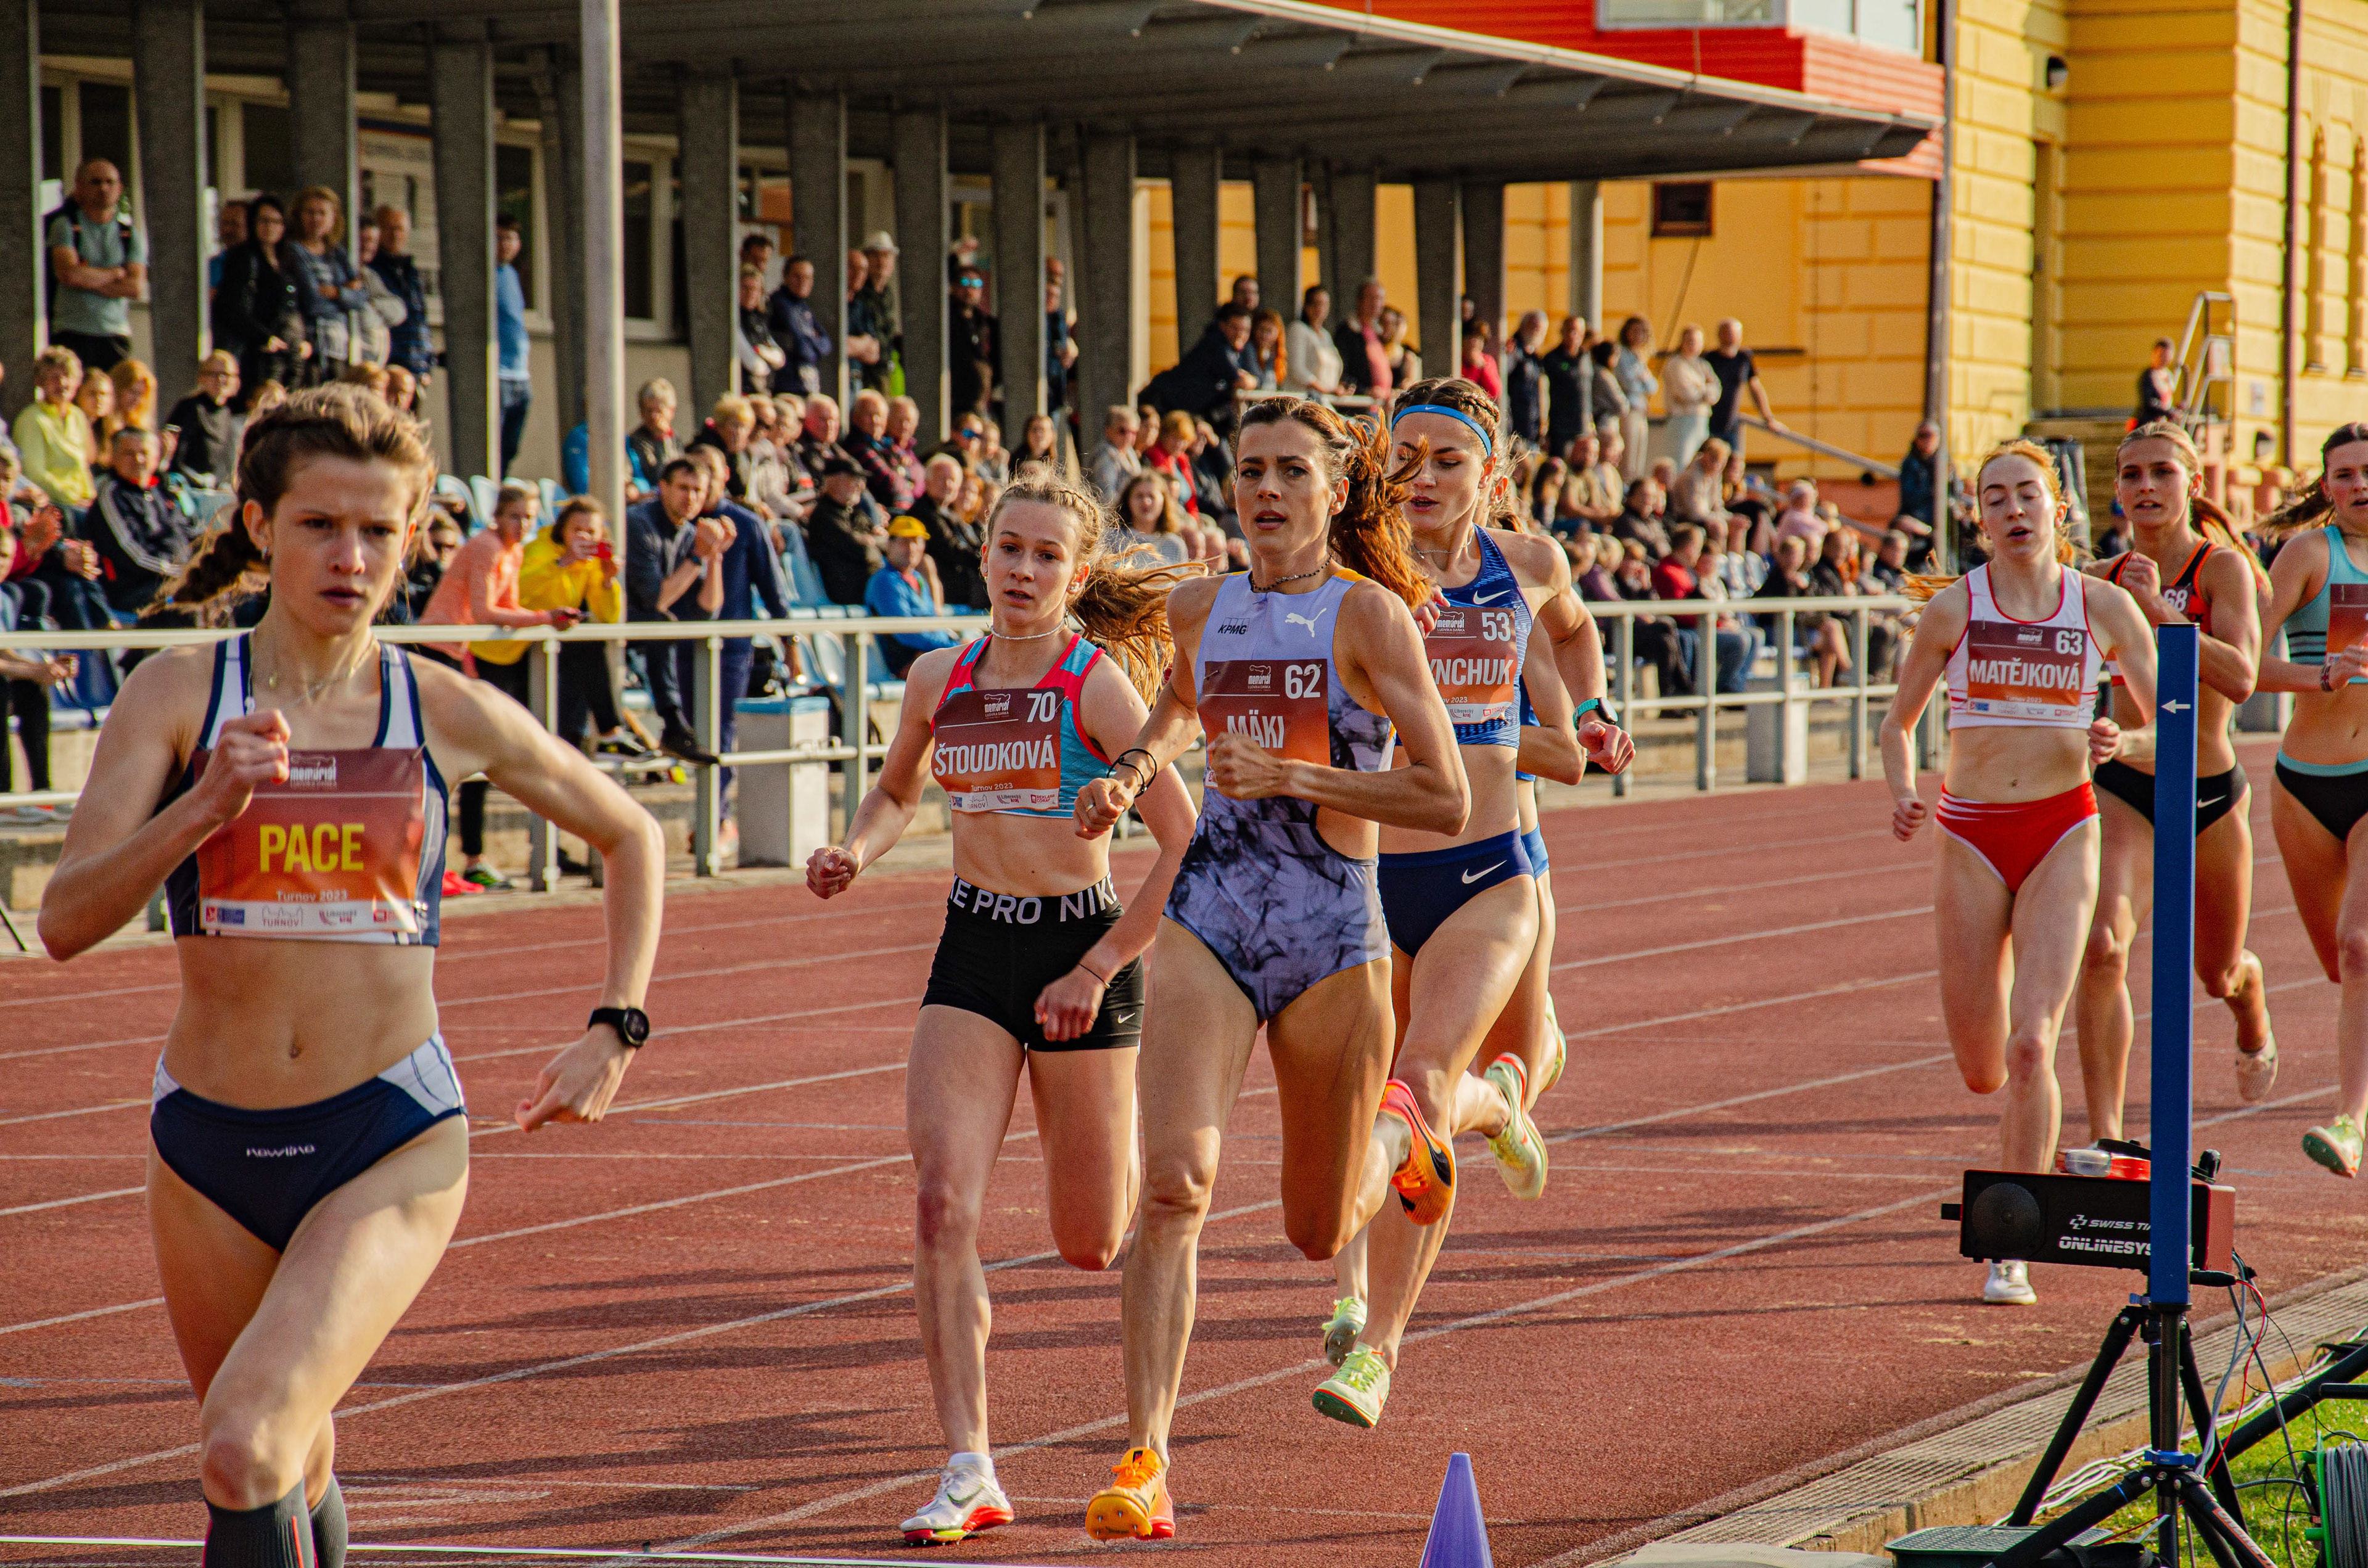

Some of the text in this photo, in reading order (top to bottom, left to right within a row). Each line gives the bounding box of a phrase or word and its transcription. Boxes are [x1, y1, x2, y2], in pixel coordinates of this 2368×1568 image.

[1217, 625, 1248, 634] KPMG
[1481, 612, 1511, 641] 53
[2055, 630, 2083, 655] 63
[1285, 664, 1321, 699] 62
[1969, 657, 2080, 691] MATĚJKOVÁ
[1027, 691, 1056, 723] 70
[934, 734, 1056, 777] ŠTOUDKOVÁ
[971, 784, 993, 792] Turnov
[259, 822, 366, 874] PACE
[277, 889, 348, 901] Turnov 2023
[972, 889, 1042, 924] PRO
[2088, 1219, 2134, 1229] SWISS
